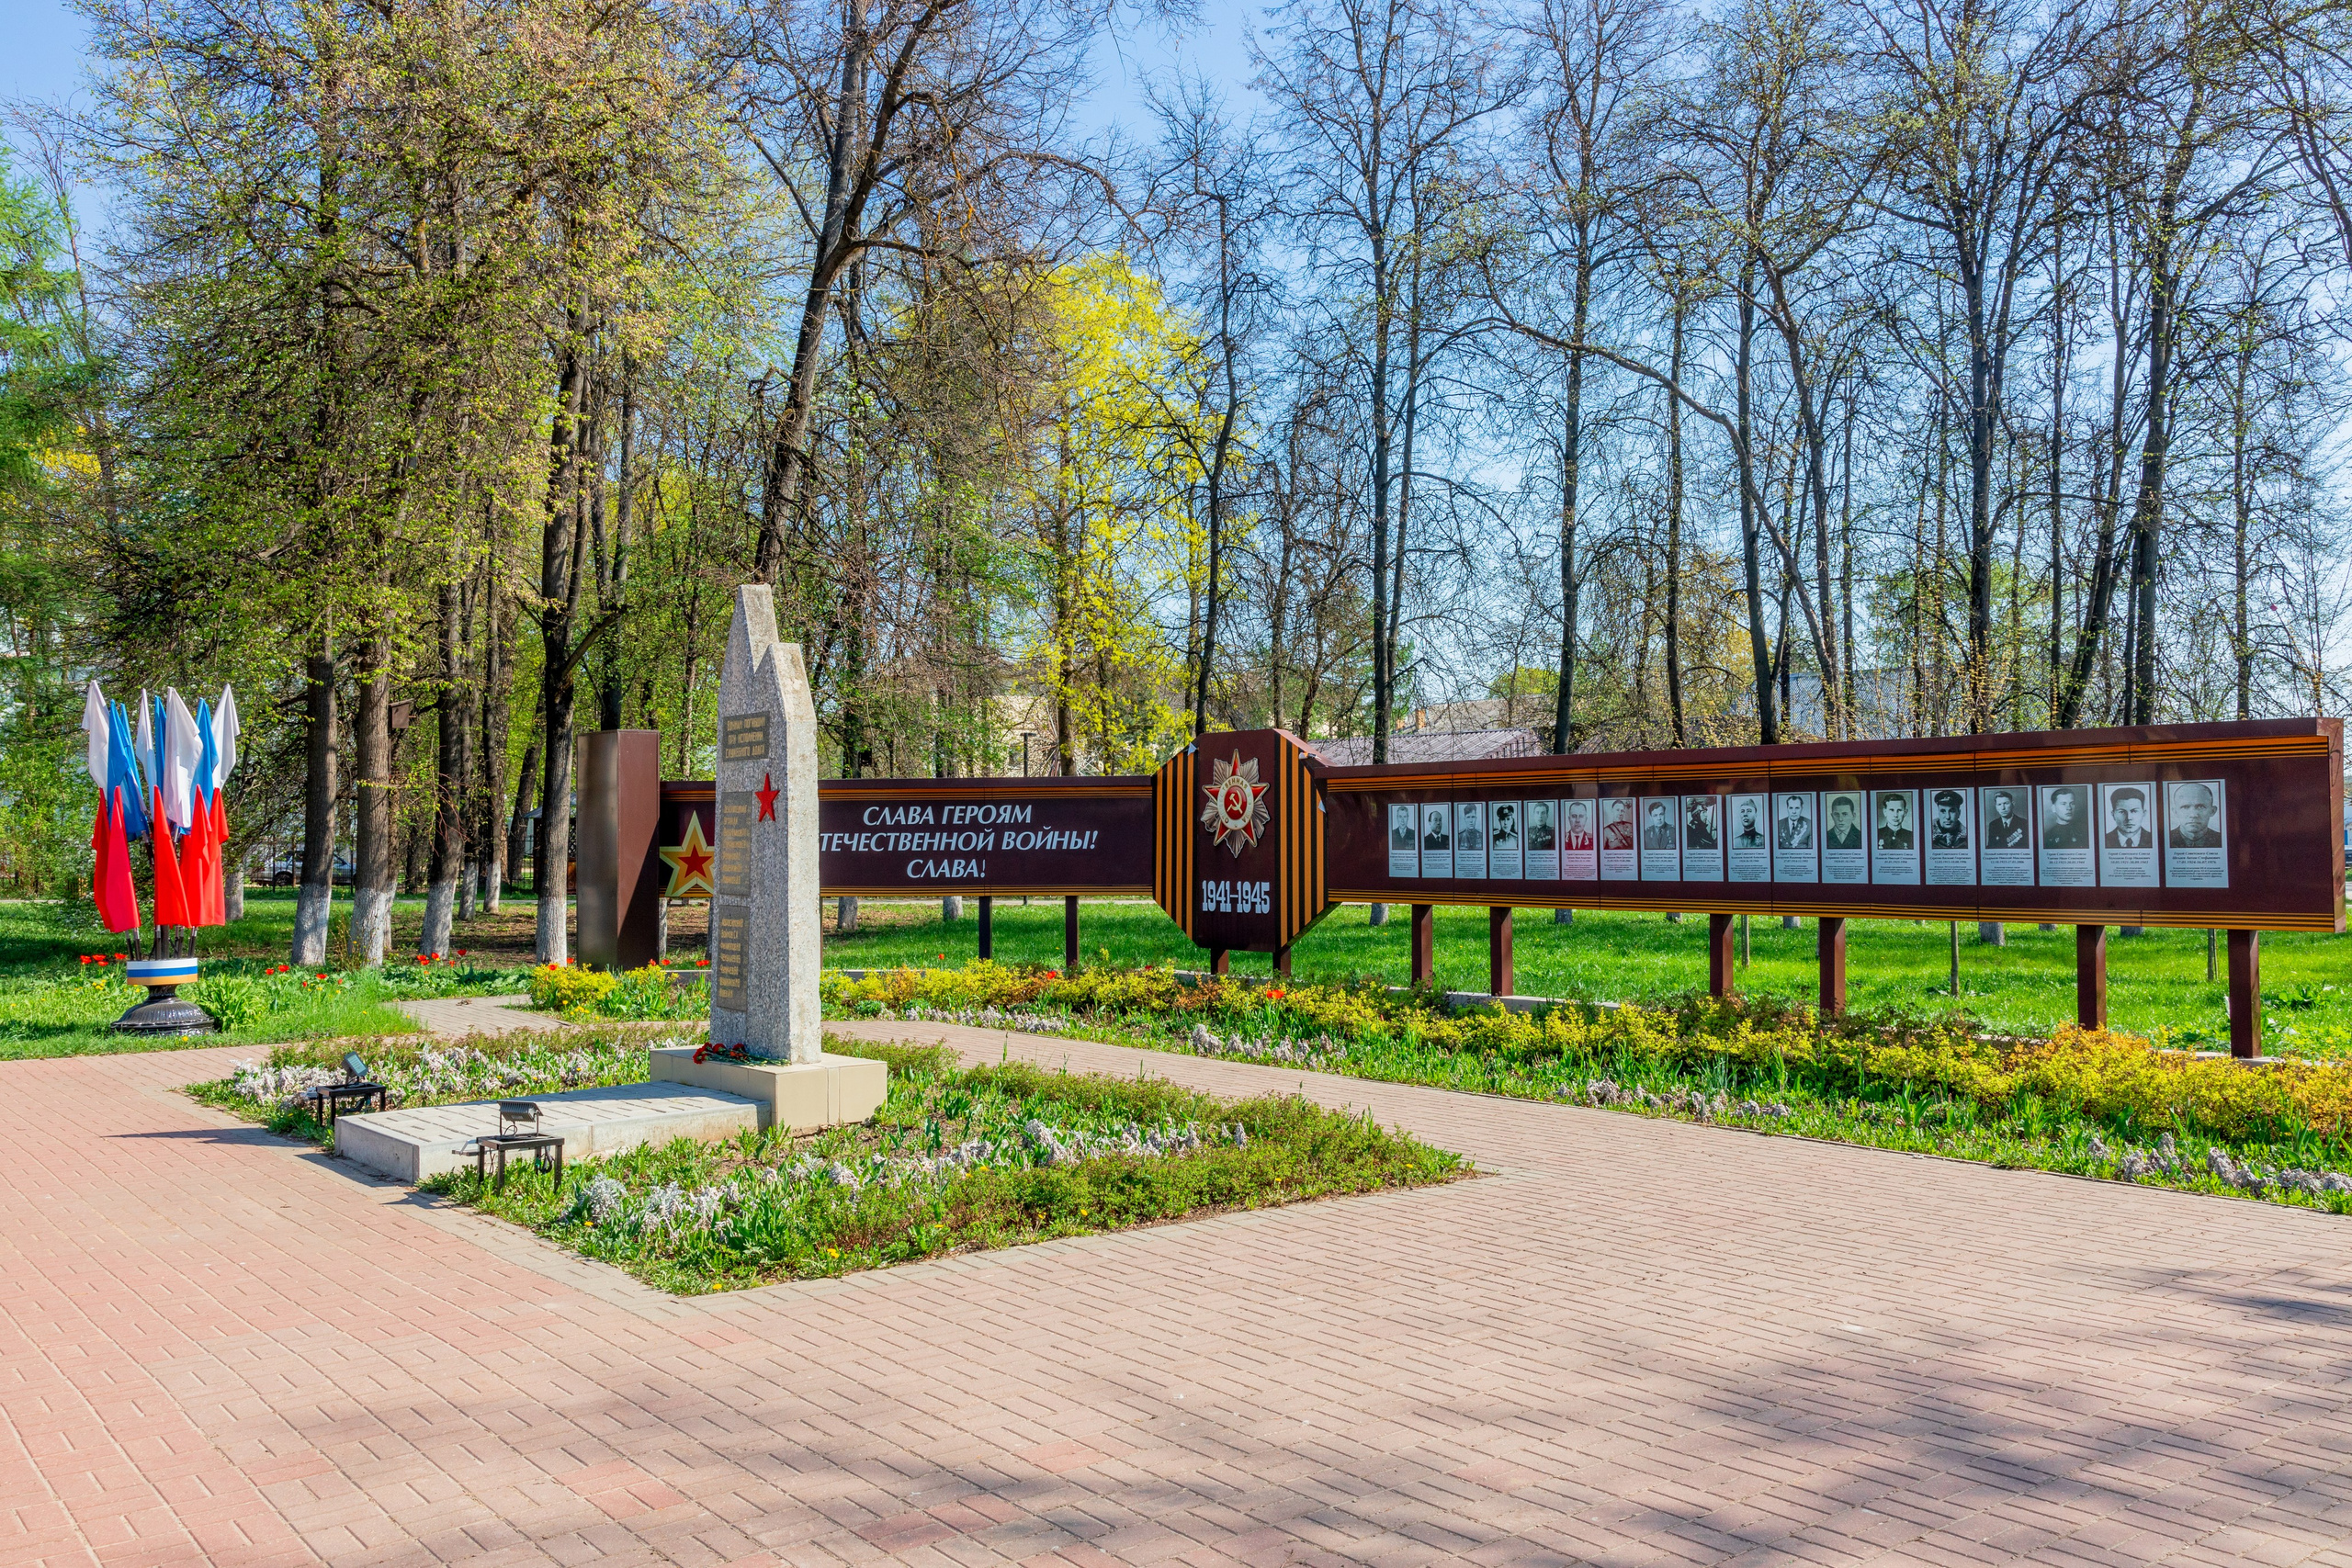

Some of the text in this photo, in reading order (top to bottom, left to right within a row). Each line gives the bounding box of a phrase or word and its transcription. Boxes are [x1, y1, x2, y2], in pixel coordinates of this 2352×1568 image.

[863, 805, 1032, 826] СЛАВА ГЕРОЯМ
[820, 825, 1098, 852] ТЕЧЕСТВЕННОЙ ВОЙНЫ!
[906, 859, 986, 878] СЛАВА!
[1202, 880, 1270, 914] 1941-1945
